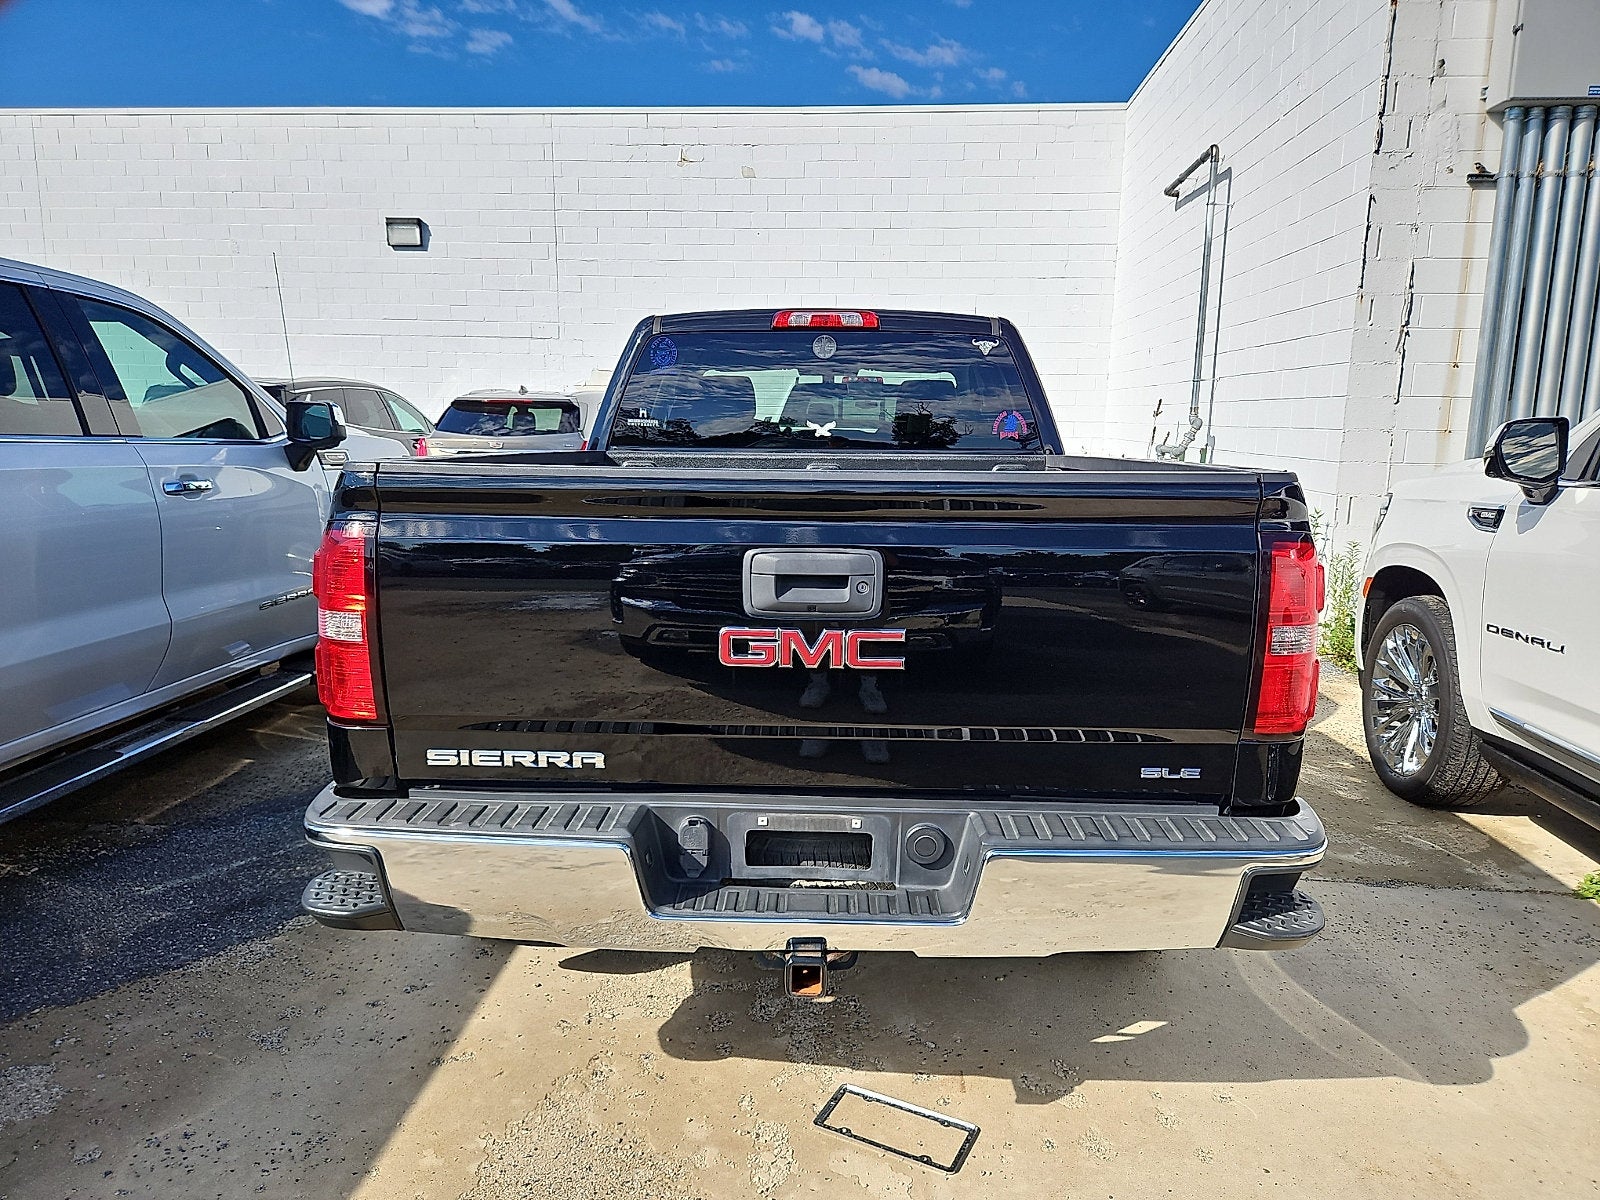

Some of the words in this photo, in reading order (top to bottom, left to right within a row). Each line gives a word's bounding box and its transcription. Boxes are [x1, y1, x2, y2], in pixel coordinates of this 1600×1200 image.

[719, 626, 907, 671] GMC
[1486, 623, 1566, 655] DENALI
[426, 748, 606, 769] SIERRA
[1140, 767, 1202, 779] SLE
